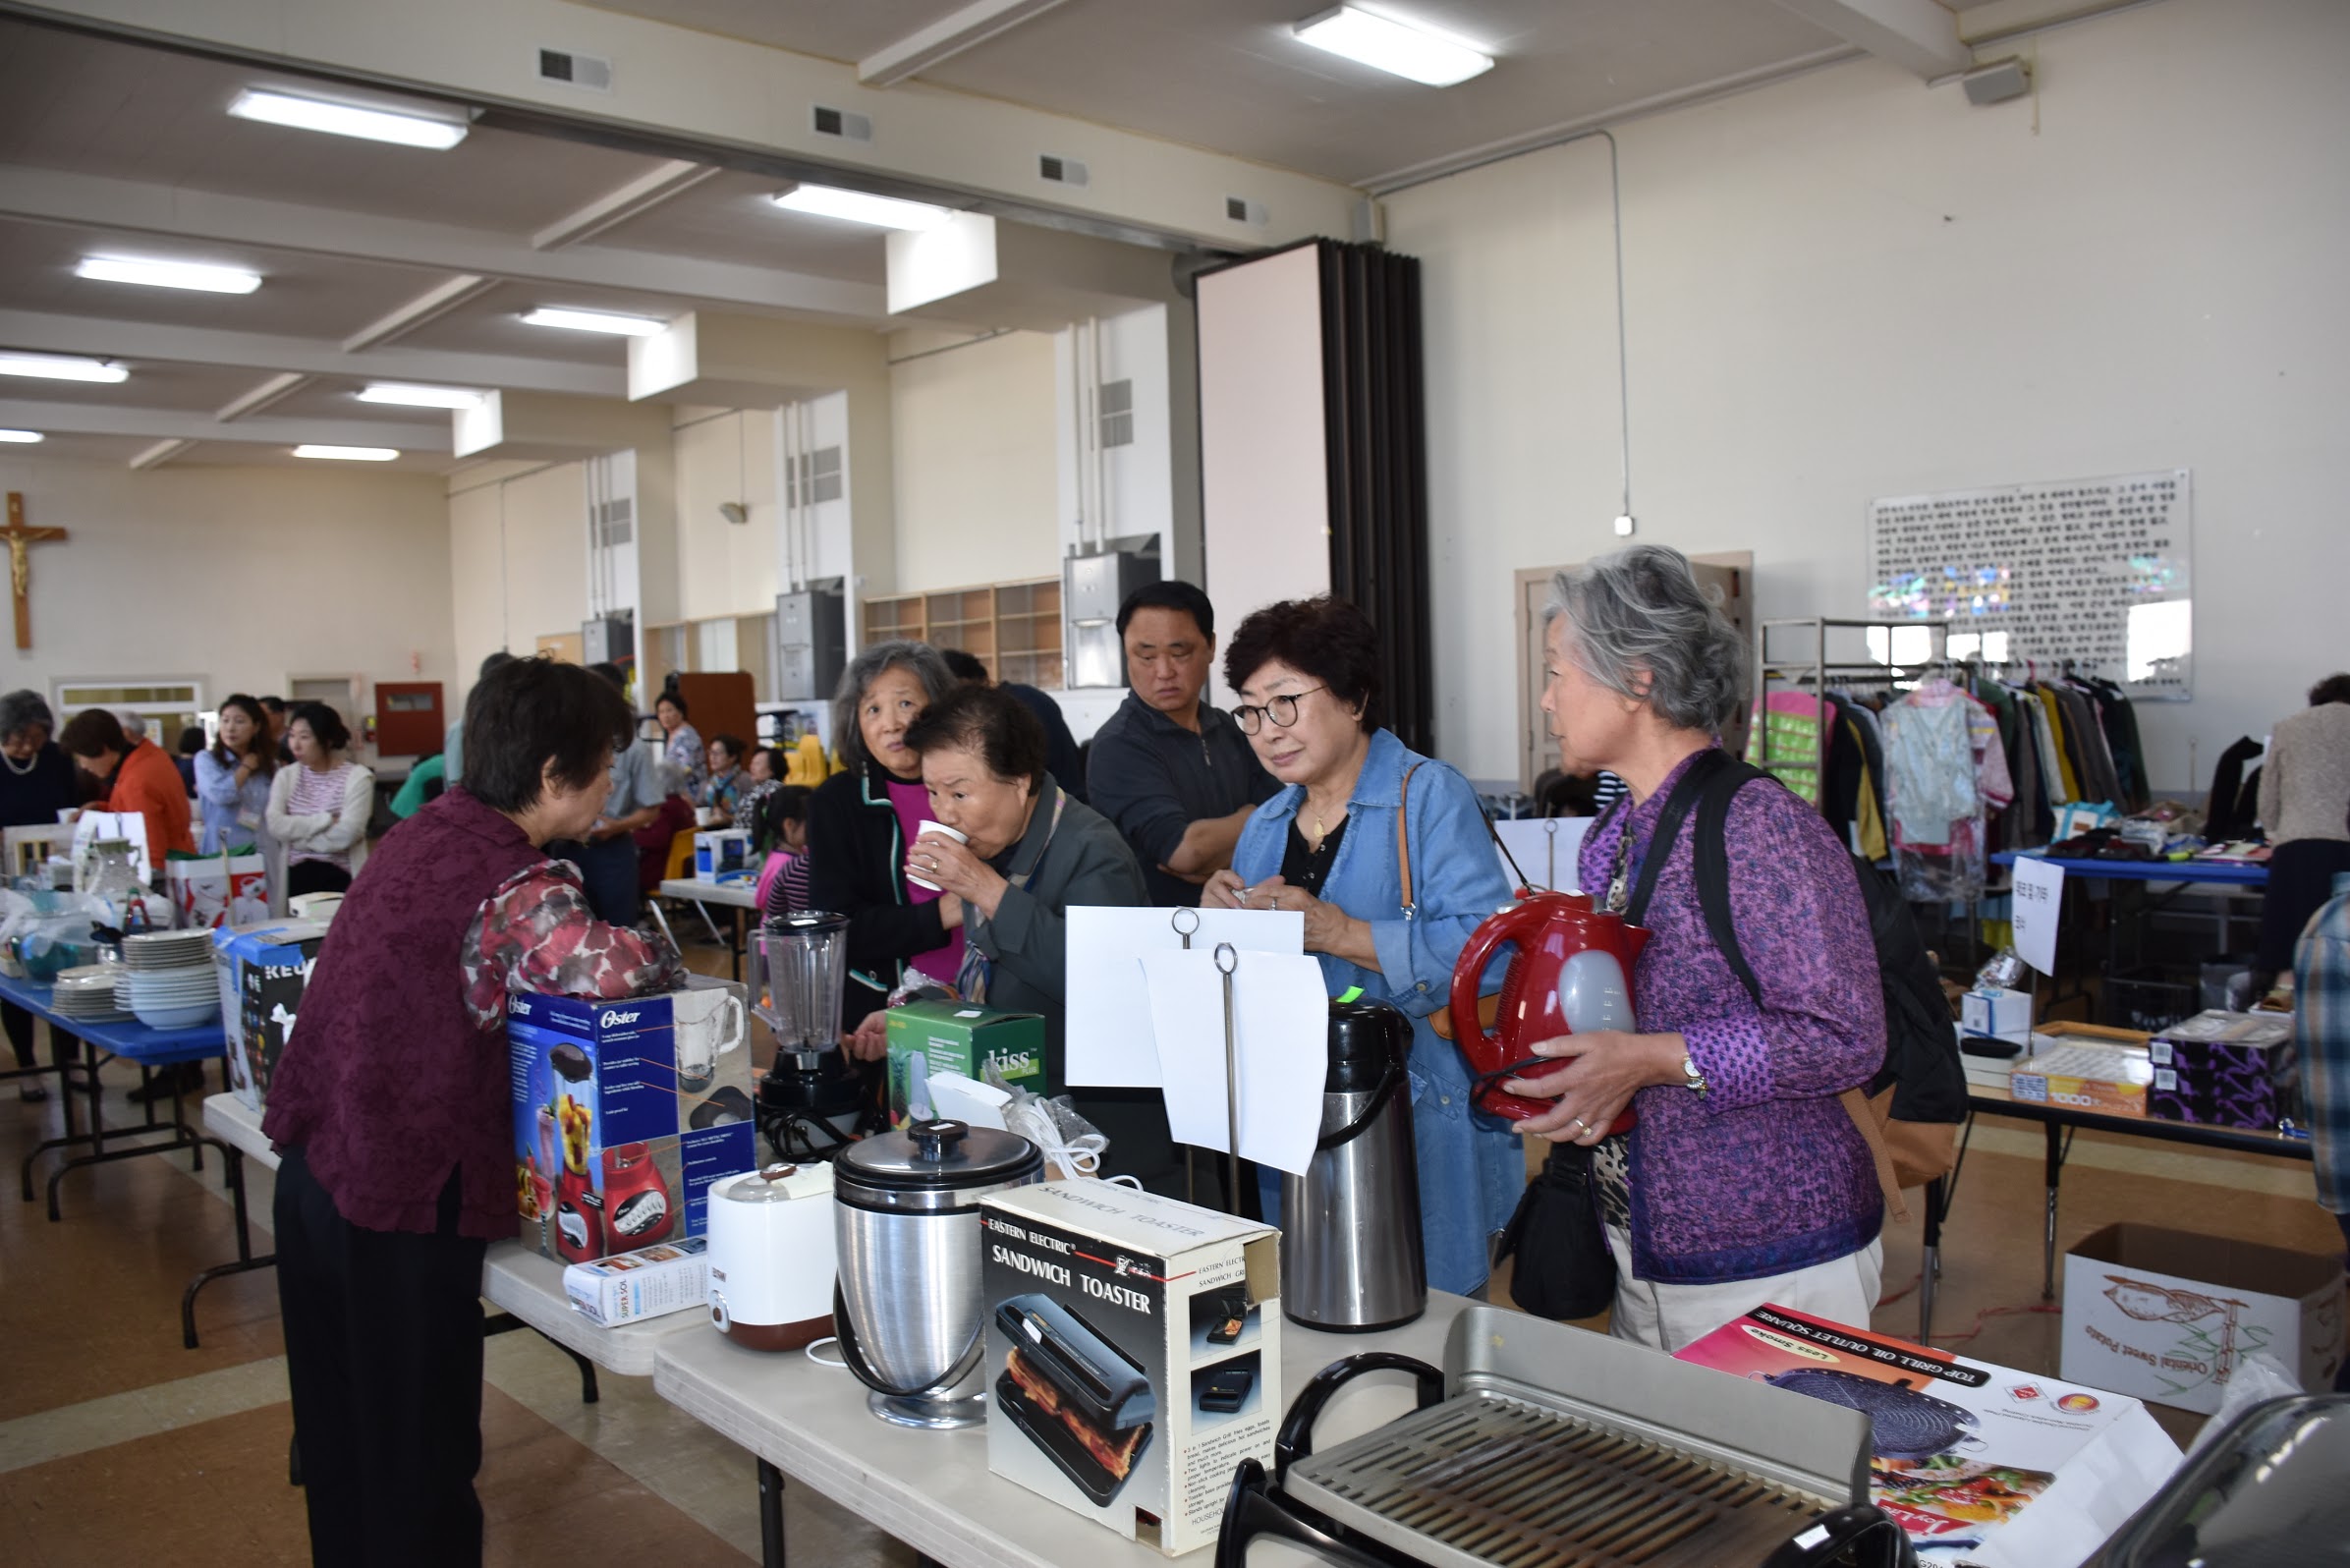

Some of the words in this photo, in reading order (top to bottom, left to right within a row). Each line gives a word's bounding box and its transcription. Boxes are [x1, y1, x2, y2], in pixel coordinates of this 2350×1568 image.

[508, 994, 532, 1015] Oster
[600, 1010, 641, 1029] Oster
[987, 1047, 1031, 1073] kiss
[1037, 1186, 1127, 1214] SANDWICH
[1131, 1213, 1205, 1237] TOASTER
[988, 1218, 1026, 1241] EASTERN
[1199, 1261, 1224, 1274] EASTERN
[992, 1244, 1072, 1287] SANDWICH
[1080, 1273, 1151, 1315] TOASTER
[1199, 1272, 1232, 1287] SANDWICH
[1755, 1311, 1813, 1335] SQUARE
[1751, 1328, 1794, 1348] Smoke
[1811, 1331, 1869, 1353] OUTLET
[2086, 1325, 2120, 1353] Potato
[1797, 1346, 1829, 1360] Less
[1872, 1347, 1896, 1361] OIL
[2122, 1345, 2156, 1366] Sweet
[1900, 1356, 1943, 1373] GRILL
[2161, 1357, 2208, 1374] Oriental
[1943, 1370, 1976, 1383] TOP
[1202, 1436, 1221, 1447] Sandwich
[1258, 1419, 1269, 1428] toasts
[1218, 1438, 1236, 1448] delicious
[1248, 1427, 1270, 1438] sandwiches
[1200, 1461, 1210, 1470] lights
[1220, 1451, 1237, 1462] indicate
[1240, 1446, 1252, 1455] power
[1187, 1473, 1201, 1482] proper
[1188, 1476, 1208, 1487] Non-stick
[1209, 1470, 1226, 1481] cooking
[1188, 1491, 1204, 1501] Toaster
[1203, 1501, 1218, 1511] upright
